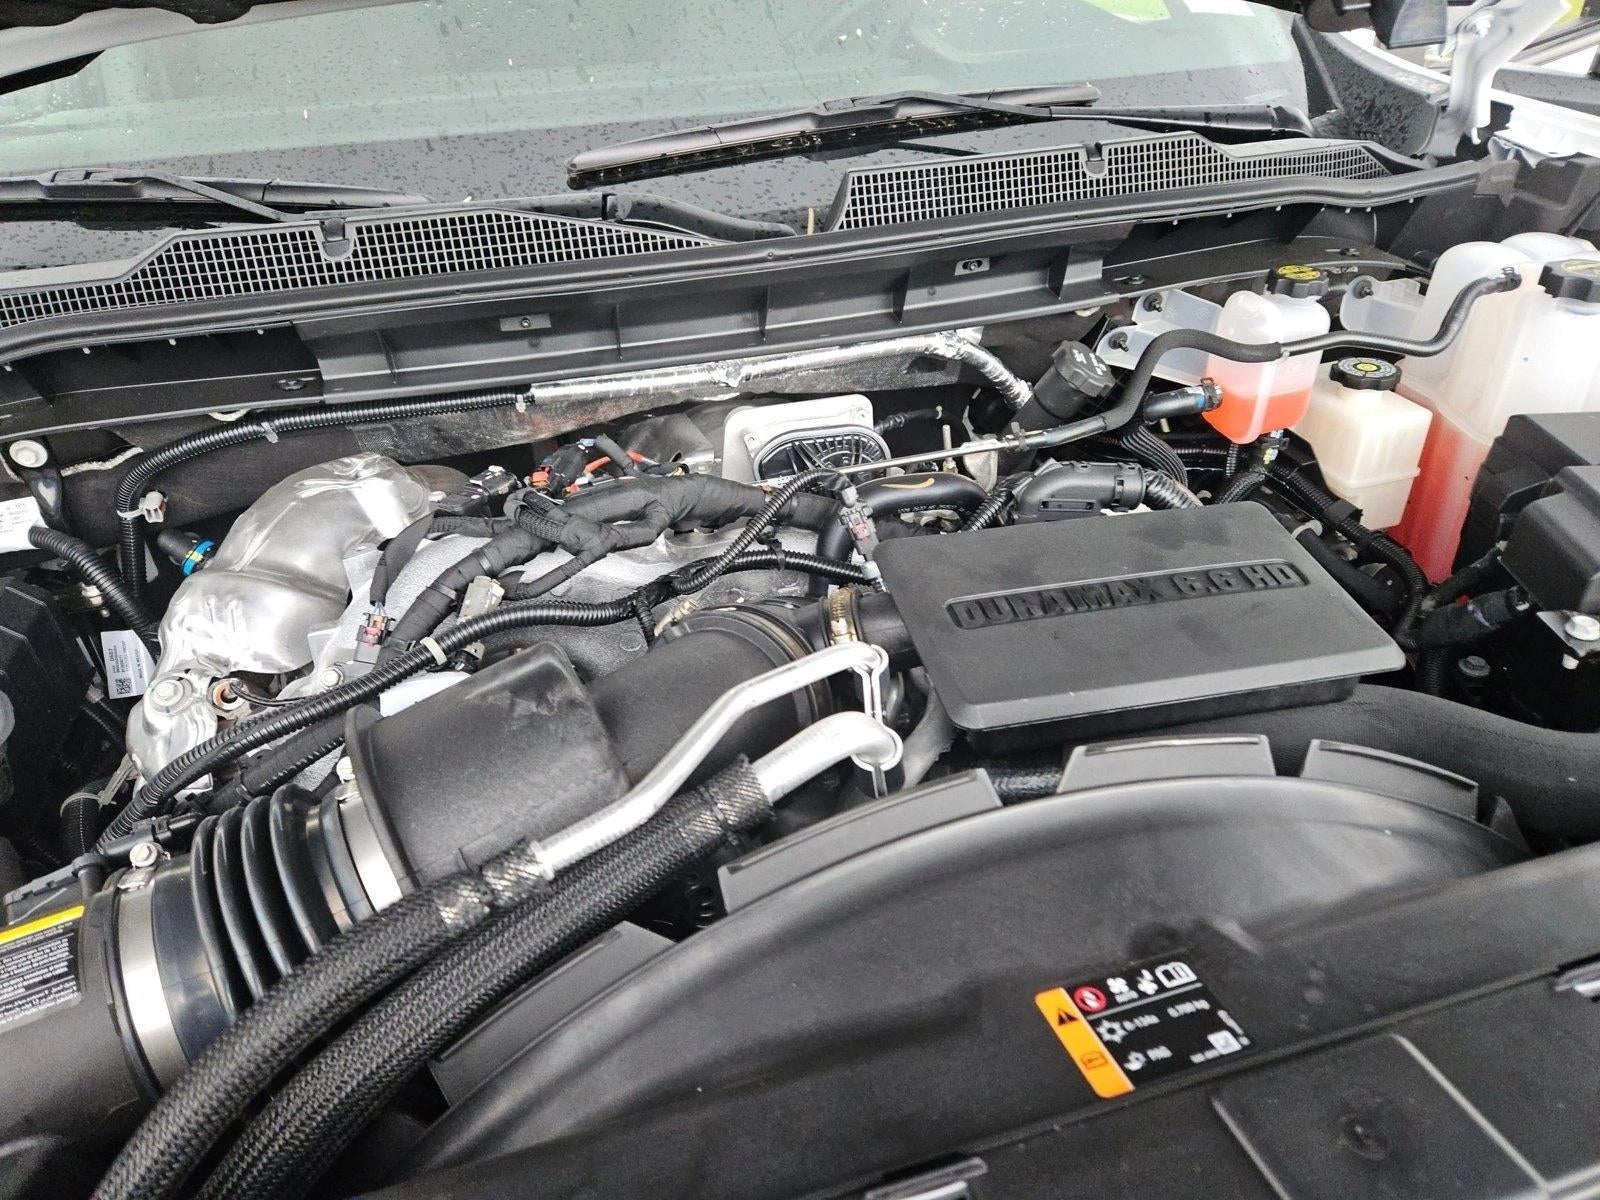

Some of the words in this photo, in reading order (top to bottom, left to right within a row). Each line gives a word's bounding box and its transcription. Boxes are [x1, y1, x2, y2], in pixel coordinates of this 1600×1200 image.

[954, 580, 1164, 628] DURAMAX
[1170, 570, 1237, 596] 6.6
[1240, 563, 1300, 590] HD
